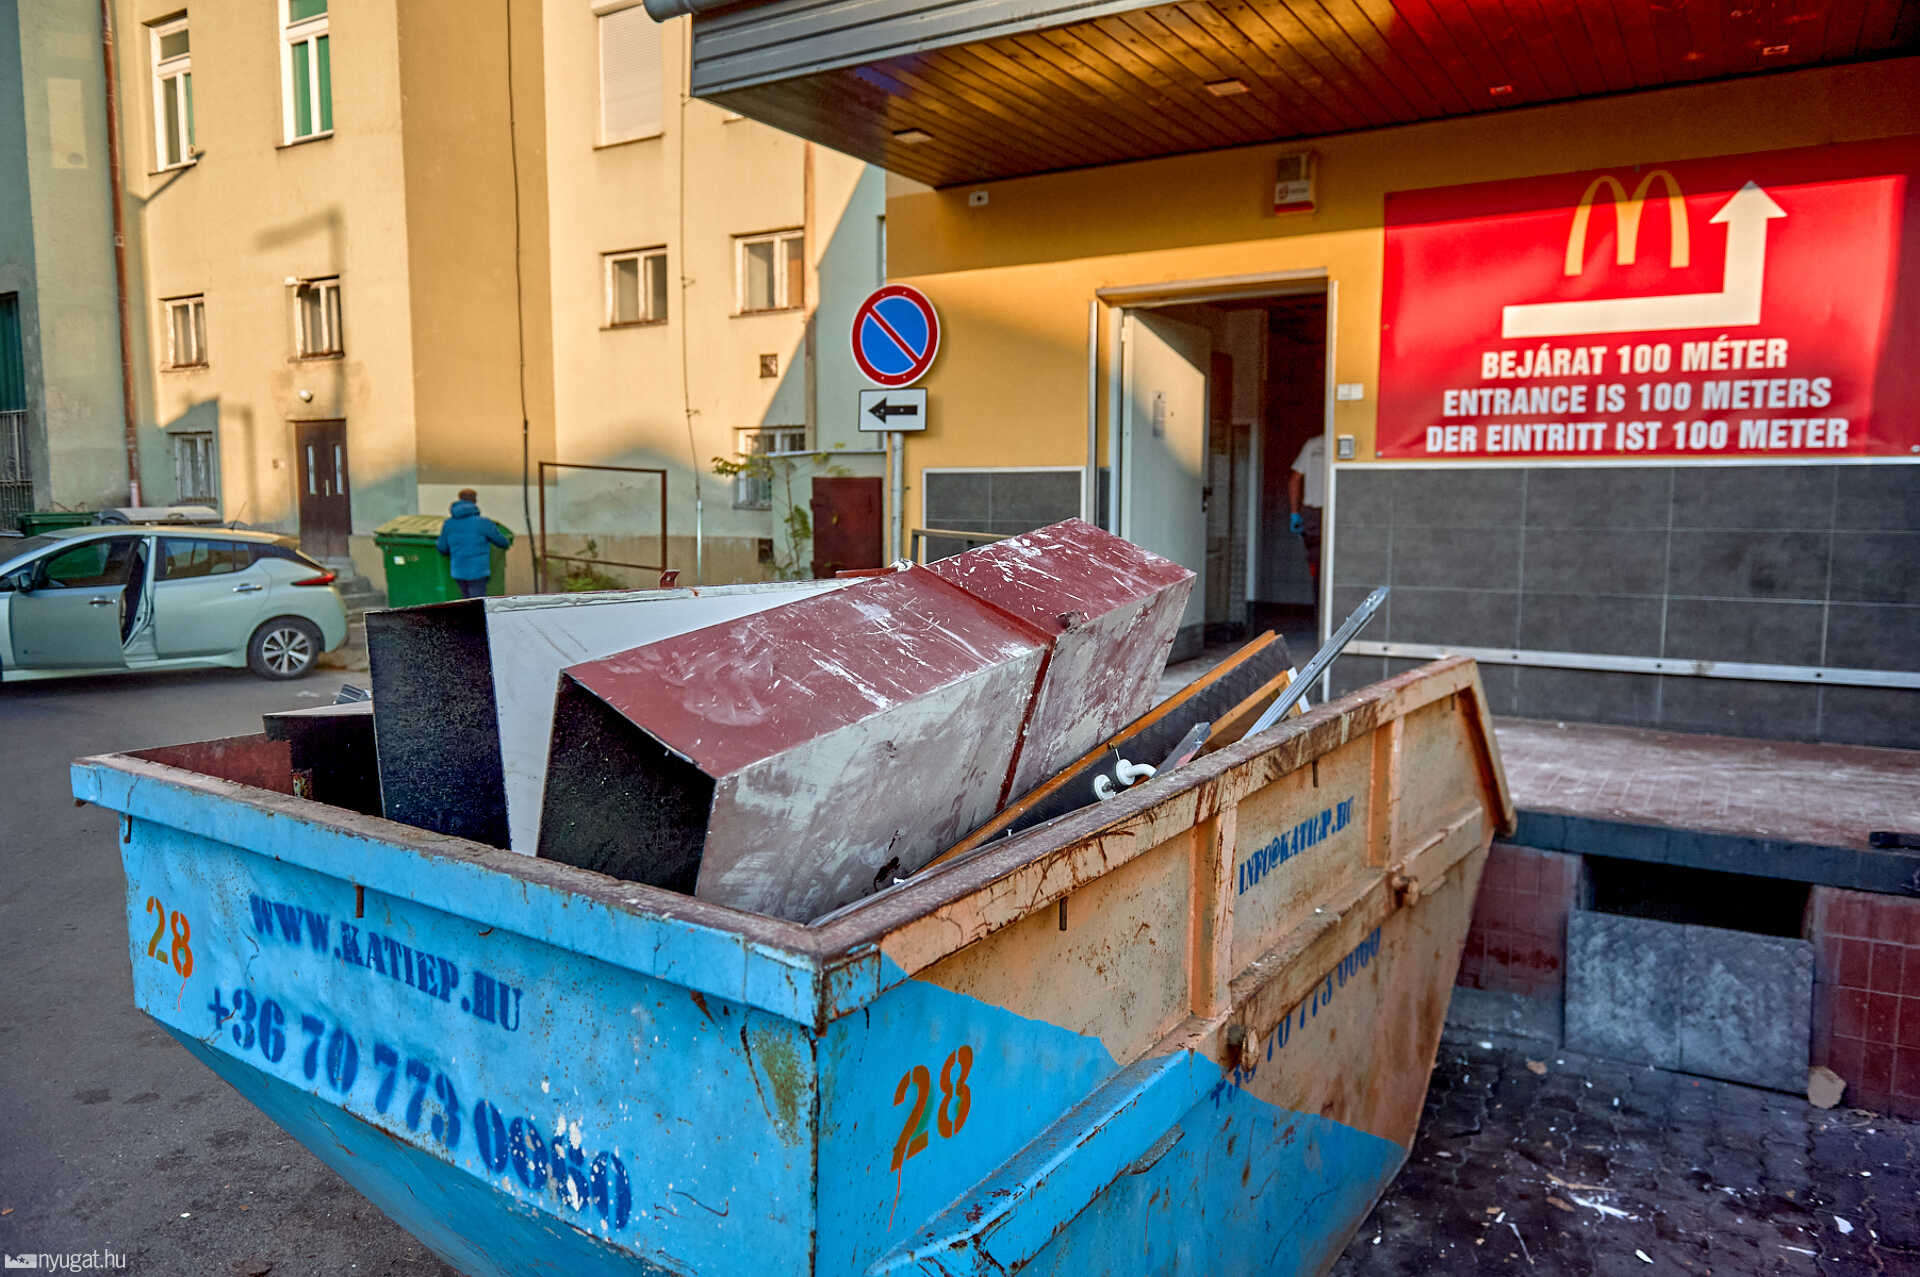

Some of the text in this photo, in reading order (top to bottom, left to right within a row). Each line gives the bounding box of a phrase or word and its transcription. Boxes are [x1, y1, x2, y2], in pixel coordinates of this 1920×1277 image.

[1443, 377, 1832, 416] ENTRANCE IS 100 METERS
[1481, 334, 1788, 380] BEJÁRAT 100 MÉTER
[1426, 418, 1849, 453] DER EINTRITT IST 100 METER
[146, 896, 193, 978] 28
[250, 893, 524, 1032] WWW.KATIEP.HU
[207, 987, 286, 1063] +36
[301, 1013, 359, 1094] 70
[374, 1042, 461, 1148] 773
[890, 1045, 973, 1173] 28
